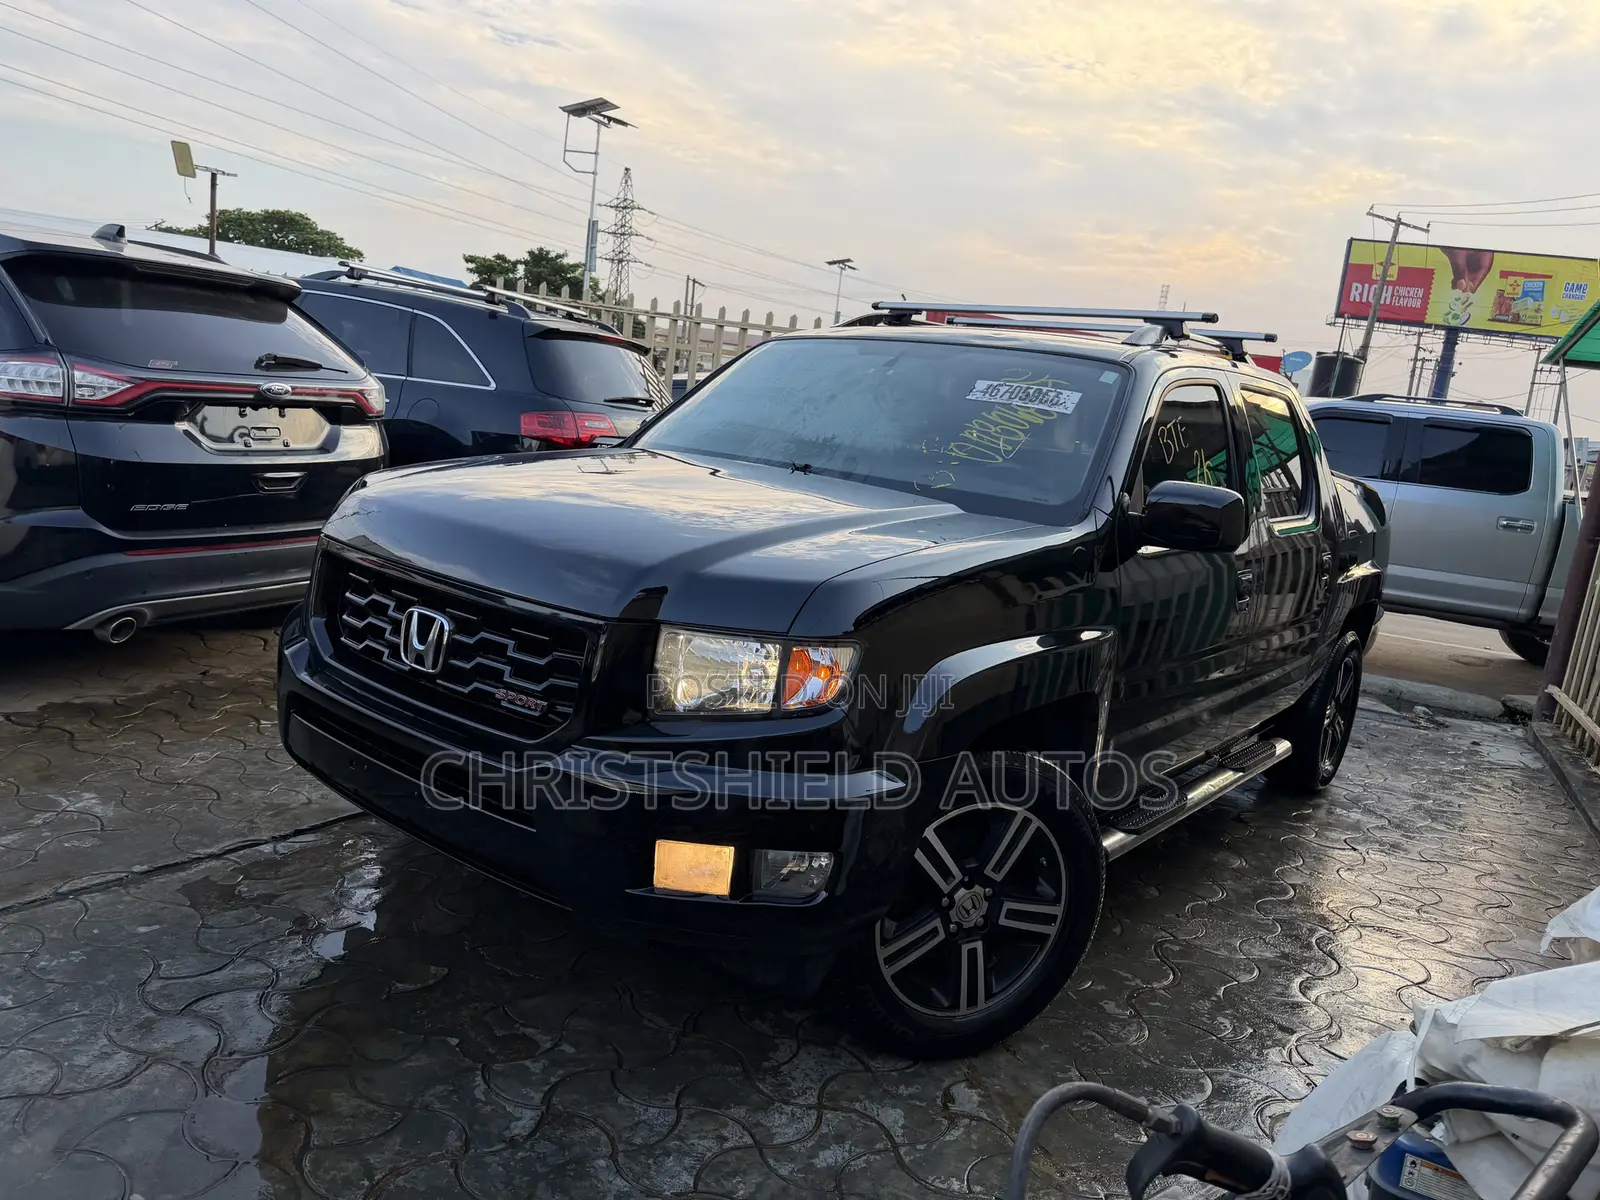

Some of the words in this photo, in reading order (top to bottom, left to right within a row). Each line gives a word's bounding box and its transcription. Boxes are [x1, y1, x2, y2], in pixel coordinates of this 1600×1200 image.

[1394, 286, 1424, 298] CHICKEN
[1392, 296, 1422, 308] FLAVOUR
[130, 503, 189, 511] EDGE
[495, 688, 547, 712] SPORT
